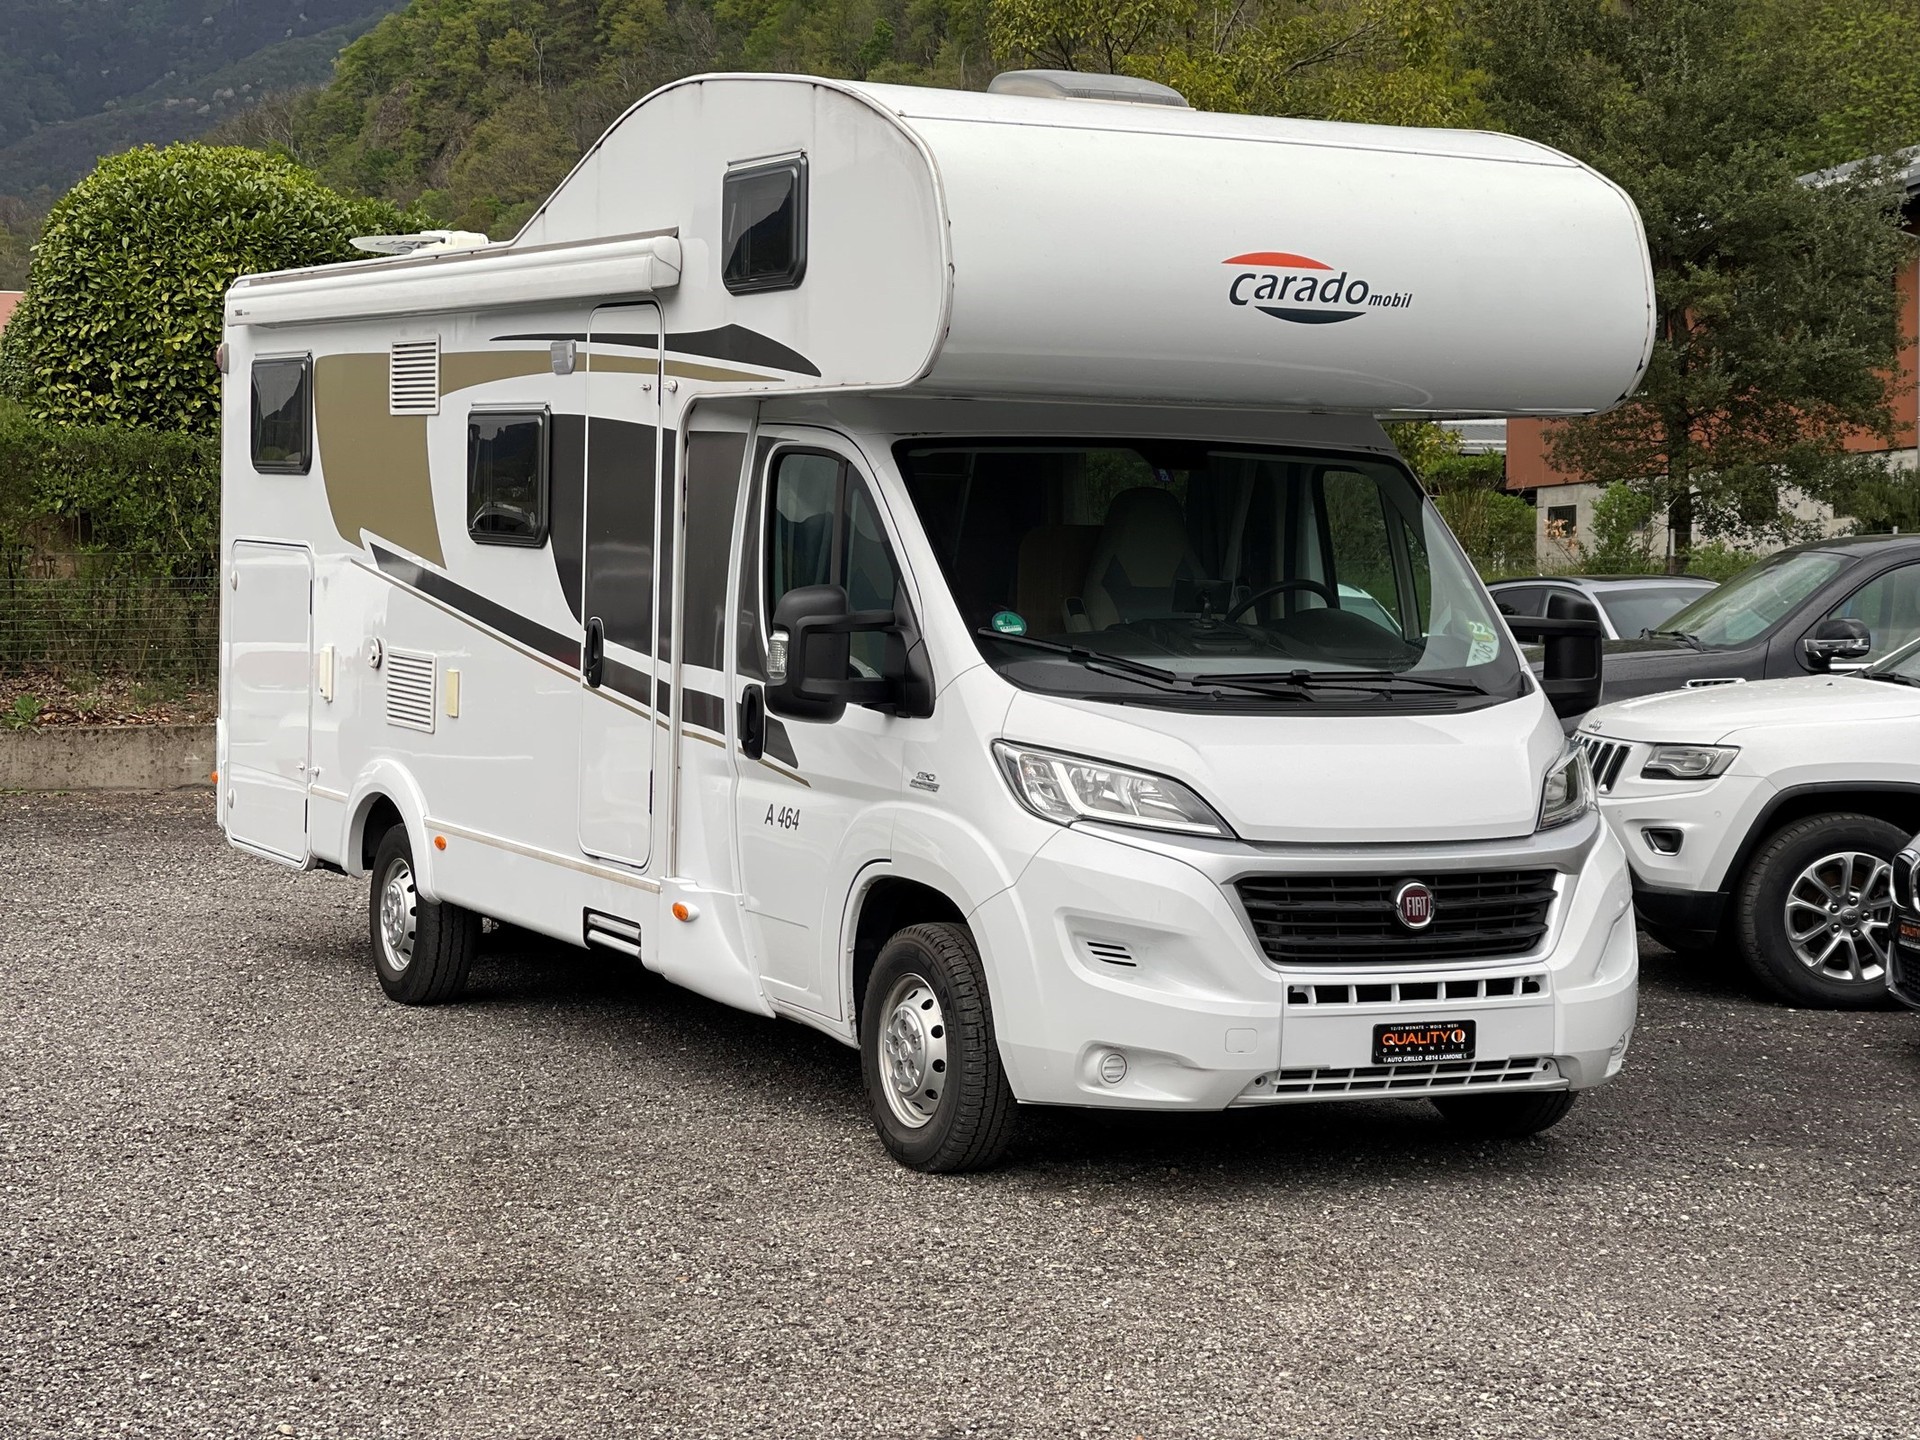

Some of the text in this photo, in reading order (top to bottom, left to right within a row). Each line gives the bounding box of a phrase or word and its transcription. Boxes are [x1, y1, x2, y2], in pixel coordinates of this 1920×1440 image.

[1229, 272, 1412, 308] carado mobil
[764, 803, 801, 831] A 464
[1405, 896, 1427, 917] FIAT
[1382, 1031, 1450, 1046] QUALITY
[1382, 1044, 1465, 1053] GARANTIE
